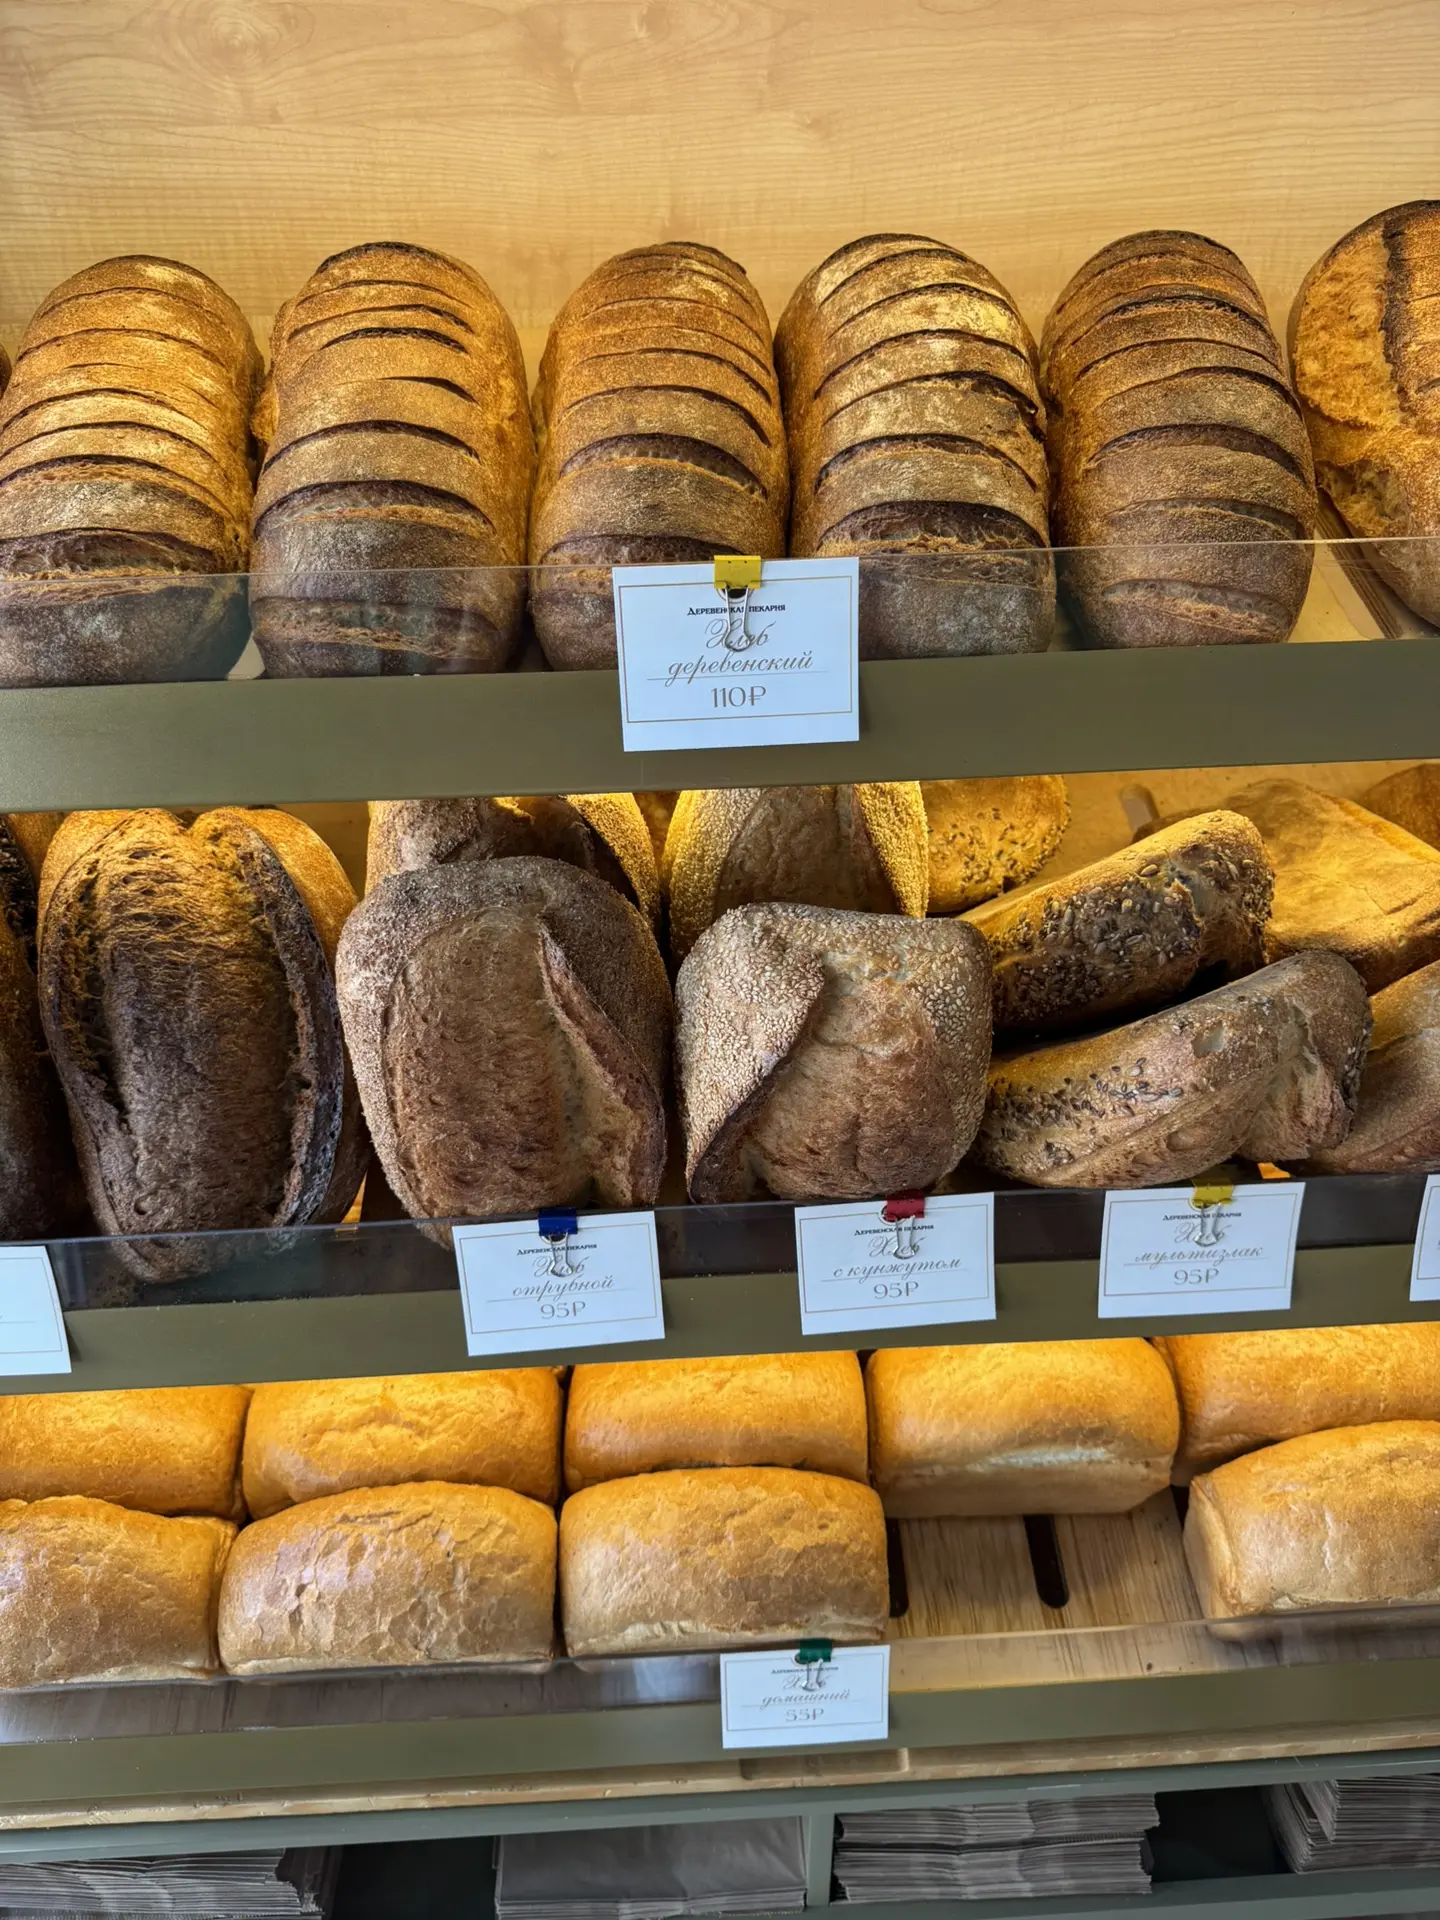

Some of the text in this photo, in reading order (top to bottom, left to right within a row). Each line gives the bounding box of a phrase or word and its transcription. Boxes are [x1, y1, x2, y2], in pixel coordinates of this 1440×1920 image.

[687, 604, 786, 616] ДЕРЕВЕНКА ПЕКАРНЯ
[664, 649, 814, 687] деревенский
[1173, 1221, 1232, 1244] Хеб
[867, 1236, 927, 1257] Хеб
[847, 1258, 962, 1285] кунжутом
[512, 1274, 614, 1302] отрубной
